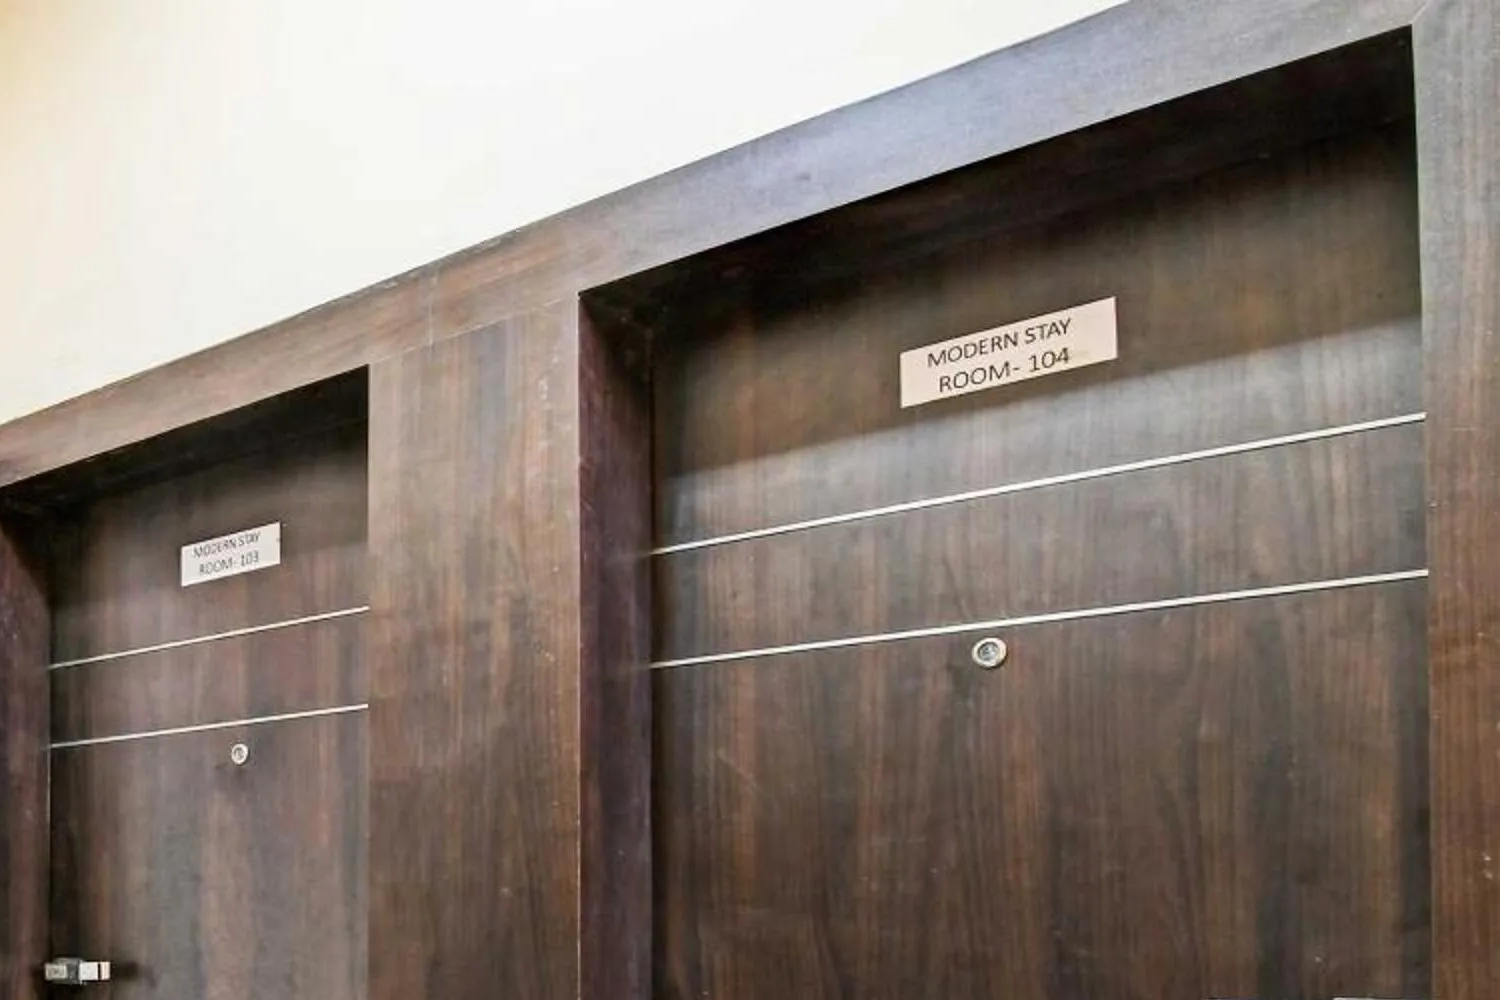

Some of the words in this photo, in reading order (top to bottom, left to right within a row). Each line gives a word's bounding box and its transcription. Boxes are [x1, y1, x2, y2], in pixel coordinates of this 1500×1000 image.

[927, 331, 1020, 368] MODERN
[1024, 317, 1073, 344] STAY
[938, 360, 1022, 393] ROOM-
[1027, 346, 1071, 373] 104
